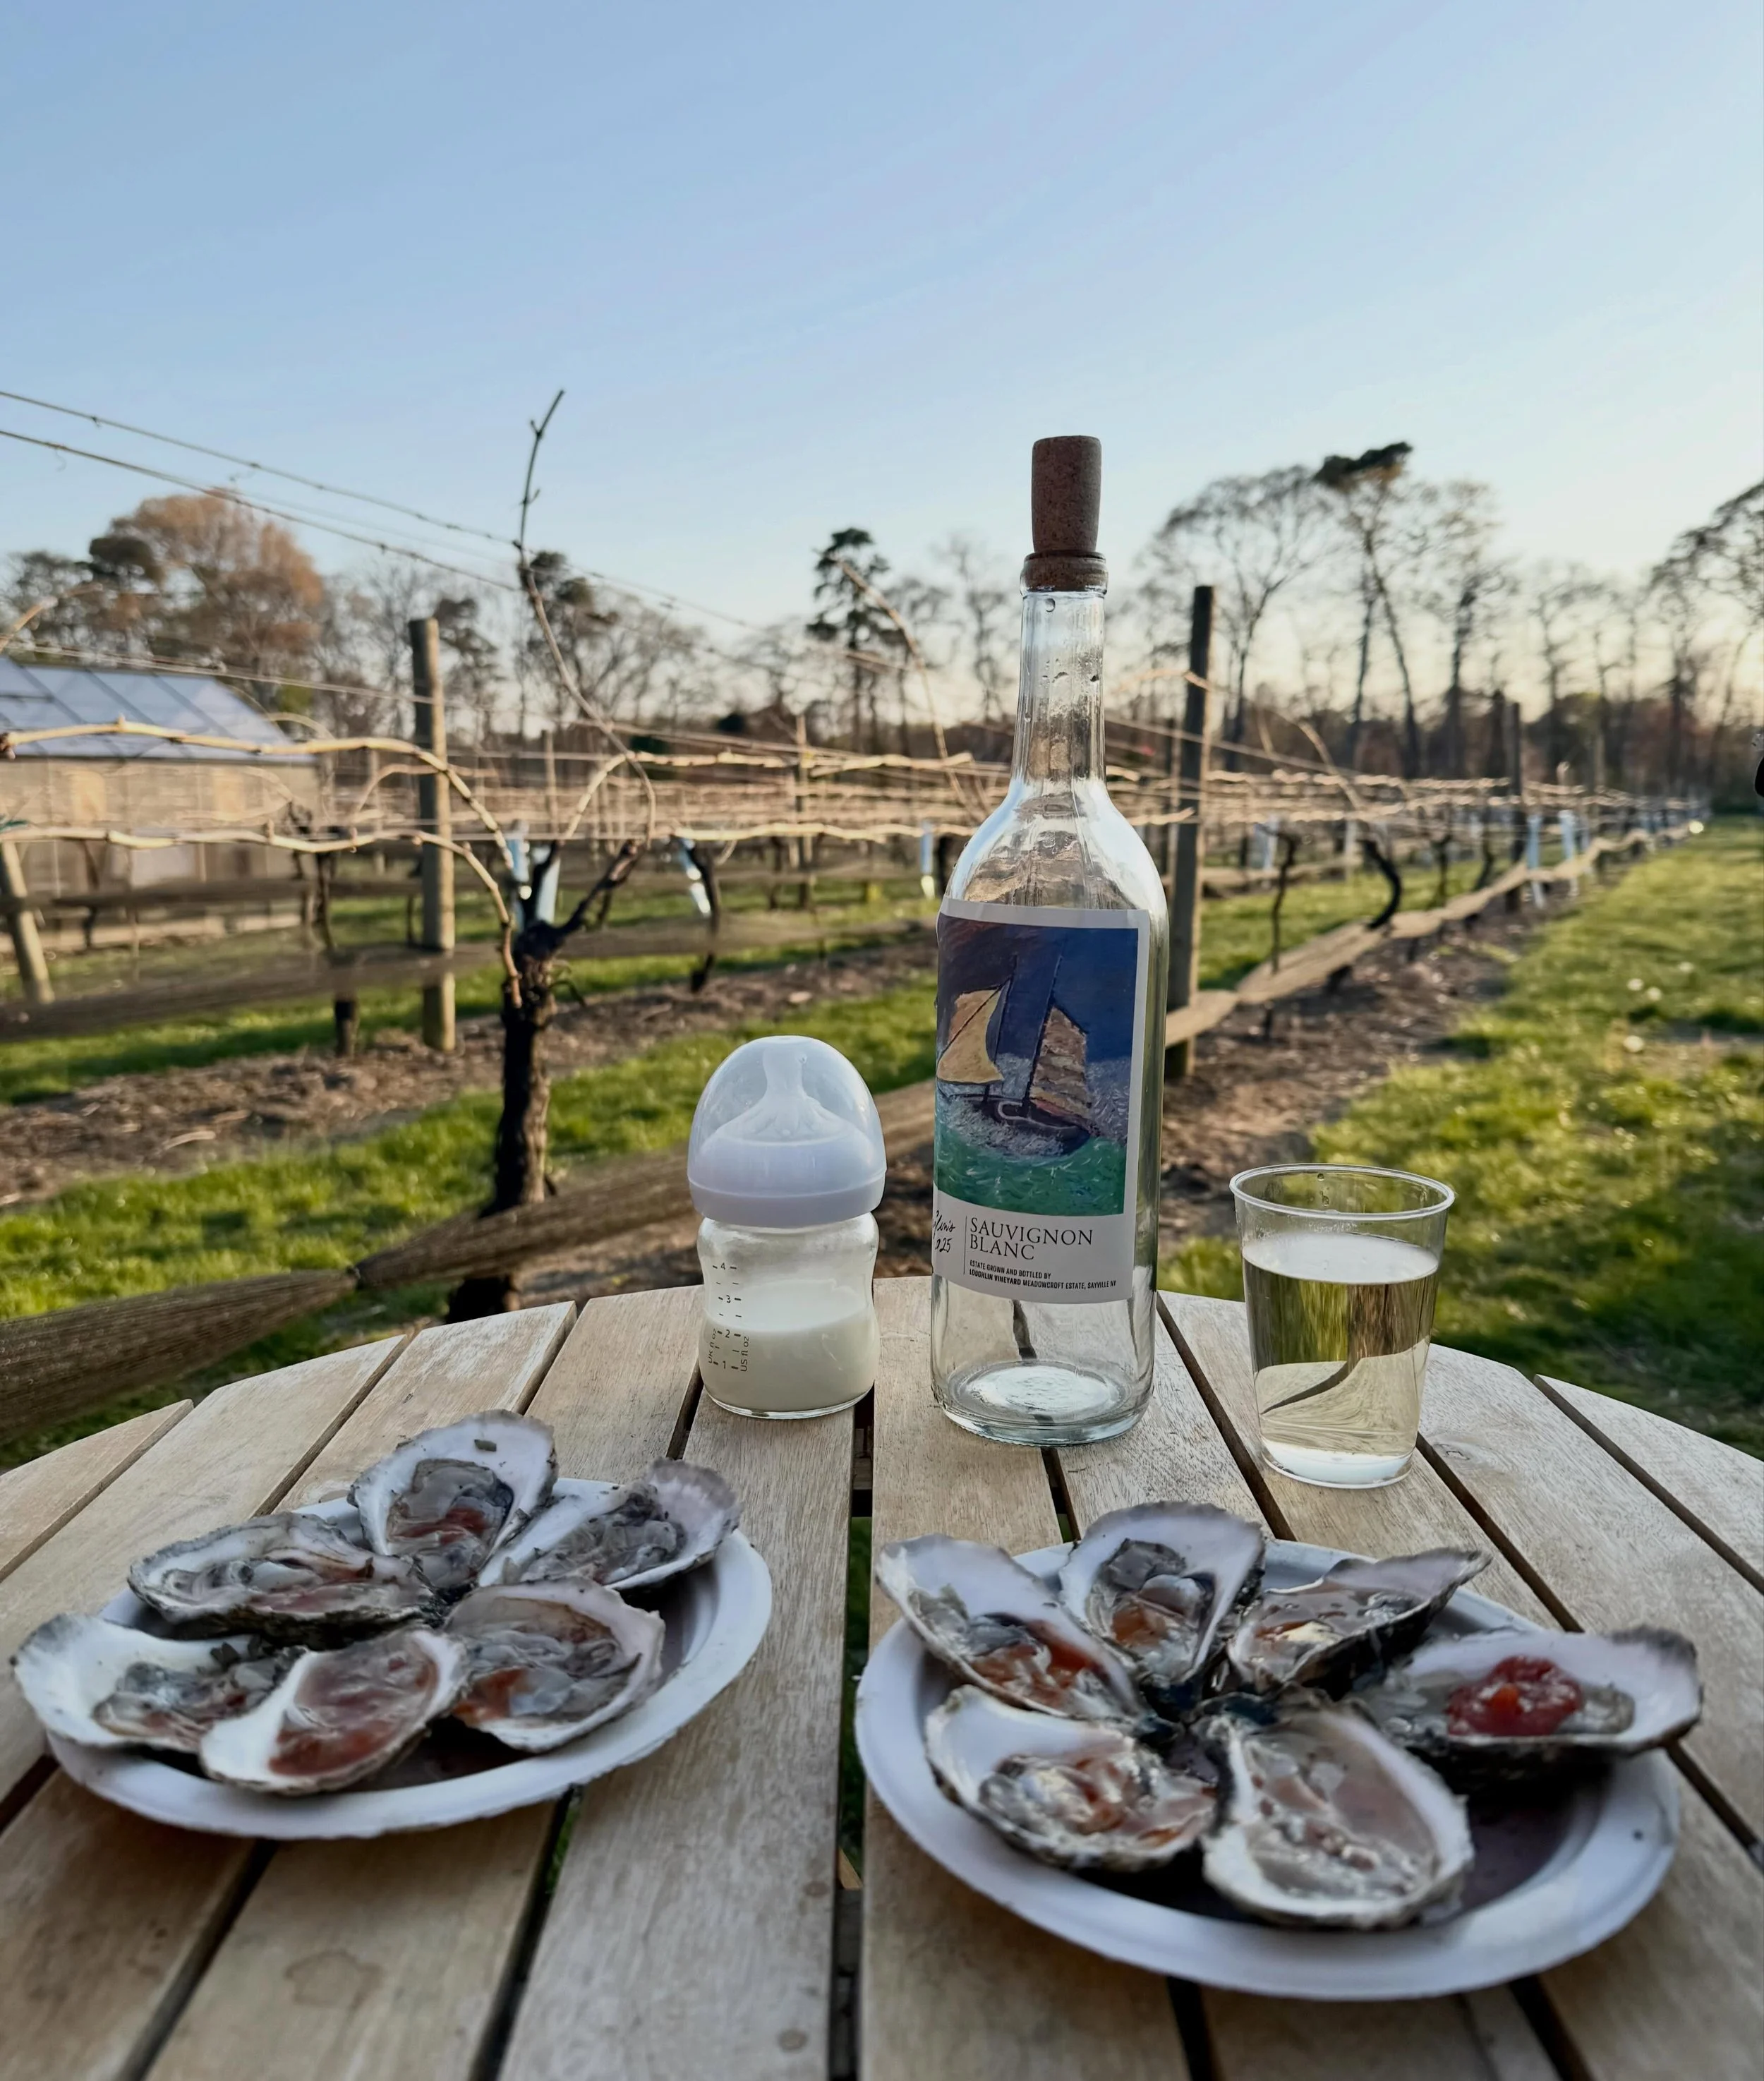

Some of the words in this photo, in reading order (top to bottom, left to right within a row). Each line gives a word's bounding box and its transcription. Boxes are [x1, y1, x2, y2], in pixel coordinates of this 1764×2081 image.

[969, 1217, 1093, 1245] SAUVIGNON
[969, 1234, 1035, 1260] BLANC
[720, 1262, 726, 1270] 4
[970, 1260, 986, 1270] ESTATE
[986, 1264, 1005, 1274] GROWN
[1006, 1267, 1017, 1276] AND
[1019, 1269, 1042, 1279] BOTTLED
[969, 1269, 993, 1281] LOUGHLIN
[994, 1274, 1021, 1286] VINEYARD
[1022, 1279, 1064, 1289] MEADOWCROFT
[726, 1294, 731, 1303] 3
[725, 1329, 730, 1339] 2
[743, 1336, 749, 1347] oz
[722, 1361, 726, 1369] 1
[740, 1359, 748, 1372] US
